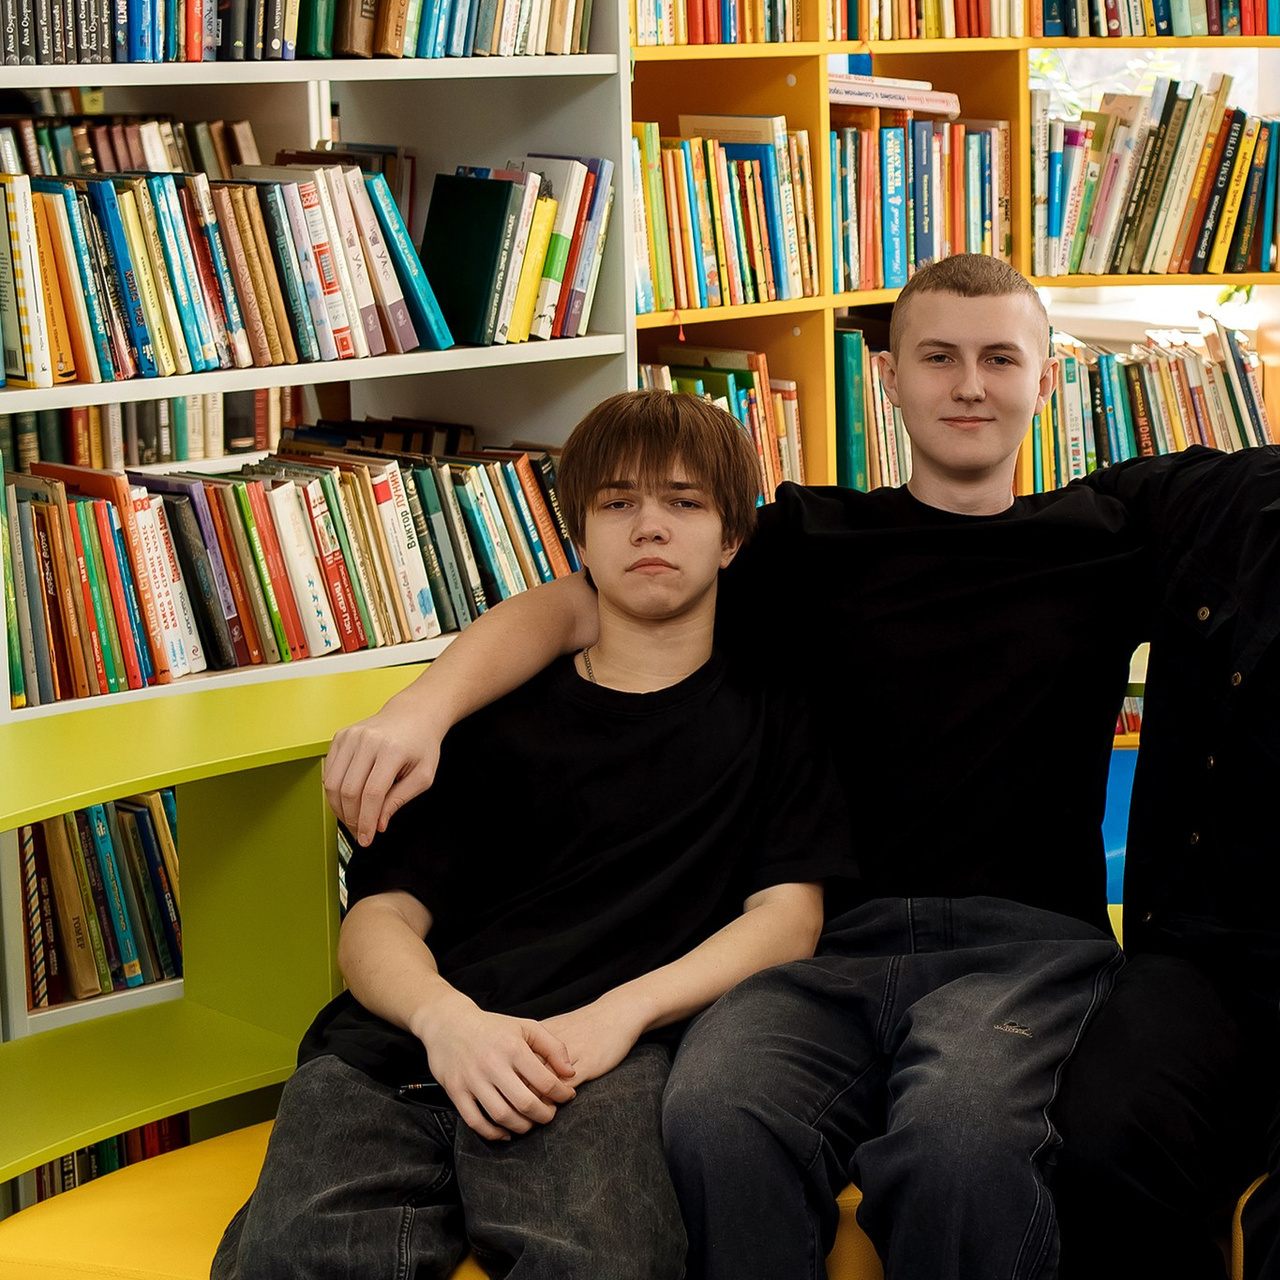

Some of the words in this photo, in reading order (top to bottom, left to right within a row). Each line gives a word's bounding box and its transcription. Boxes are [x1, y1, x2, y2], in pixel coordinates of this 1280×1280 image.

[1198, 231, 1211, 258] Борис
[1205, 195, 1220, 230] Житков
[1217, 160, 1231, 188] СЕМЬ
[1225, 122, 1241, 157] ОГНЕЙ
[124, 270, 138, 302] КНИГА
[389, 470, 406, 507] ЛУНИН
[401, 510, 416, 549] Виктор
[549, 488, 569, 539] ХРАНИТЕЛИ
[333, 581, 346, 612] ПИТЕР
